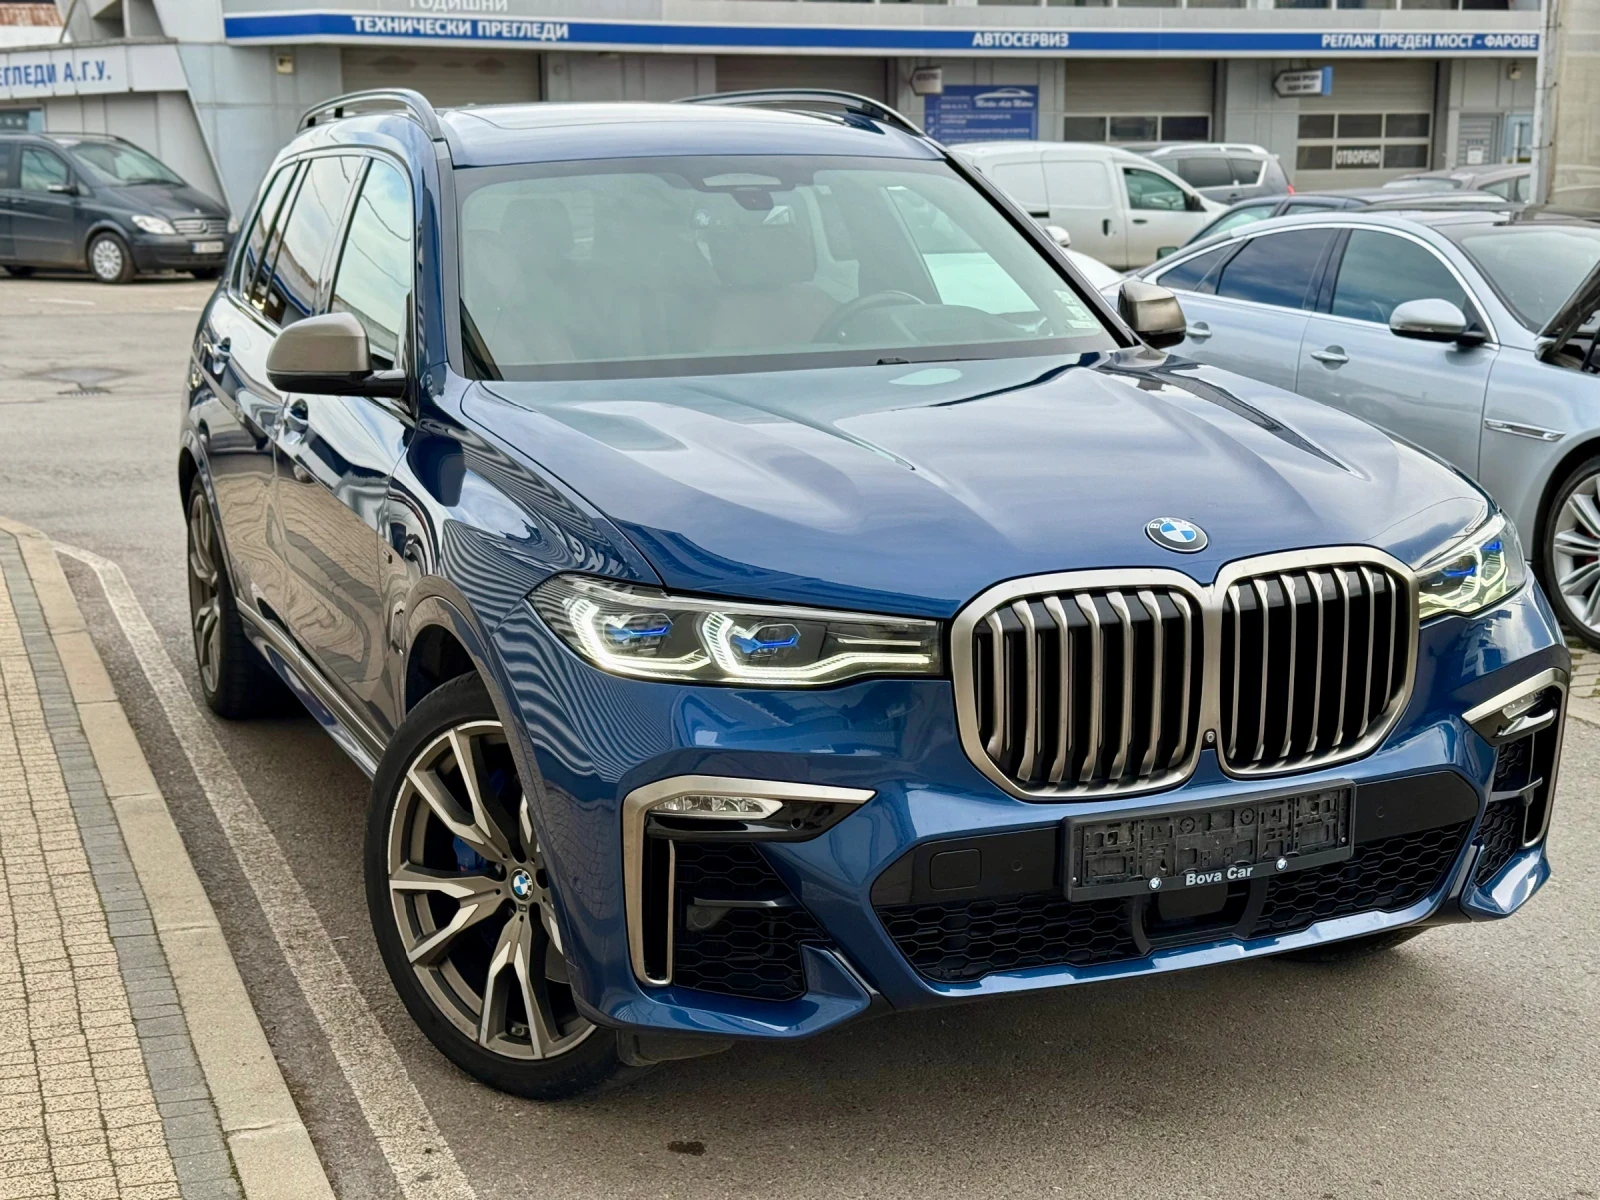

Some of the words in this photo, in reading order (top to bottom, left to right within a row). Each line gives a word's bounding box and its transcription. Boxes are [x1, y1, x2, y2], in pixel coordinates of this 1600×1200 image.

[352, 16, 471, 36] ТЕХНИЧЕСКИ
[477, 21, 569, 41] ПРЕГЛЕДИ
[972, 32, 1069, 47] АВТОСЕРВИЗ
[1321, 34, 1376, 48] РЕГЛАЖ
[1379, 34, 1432, 49] ПРЕДЕН
[1435, 34, 1475, 48] МОСТ
[1484, 34, 1536, 48] ФАРОВЕ
[0, 64, 57, 88] ГЛЕДИ
[1335, 150, 1380, 164] ОТВОРЕНО
[1185, 872, 1222, 886] Bova
[1227, 867, 1254, 880] Car
